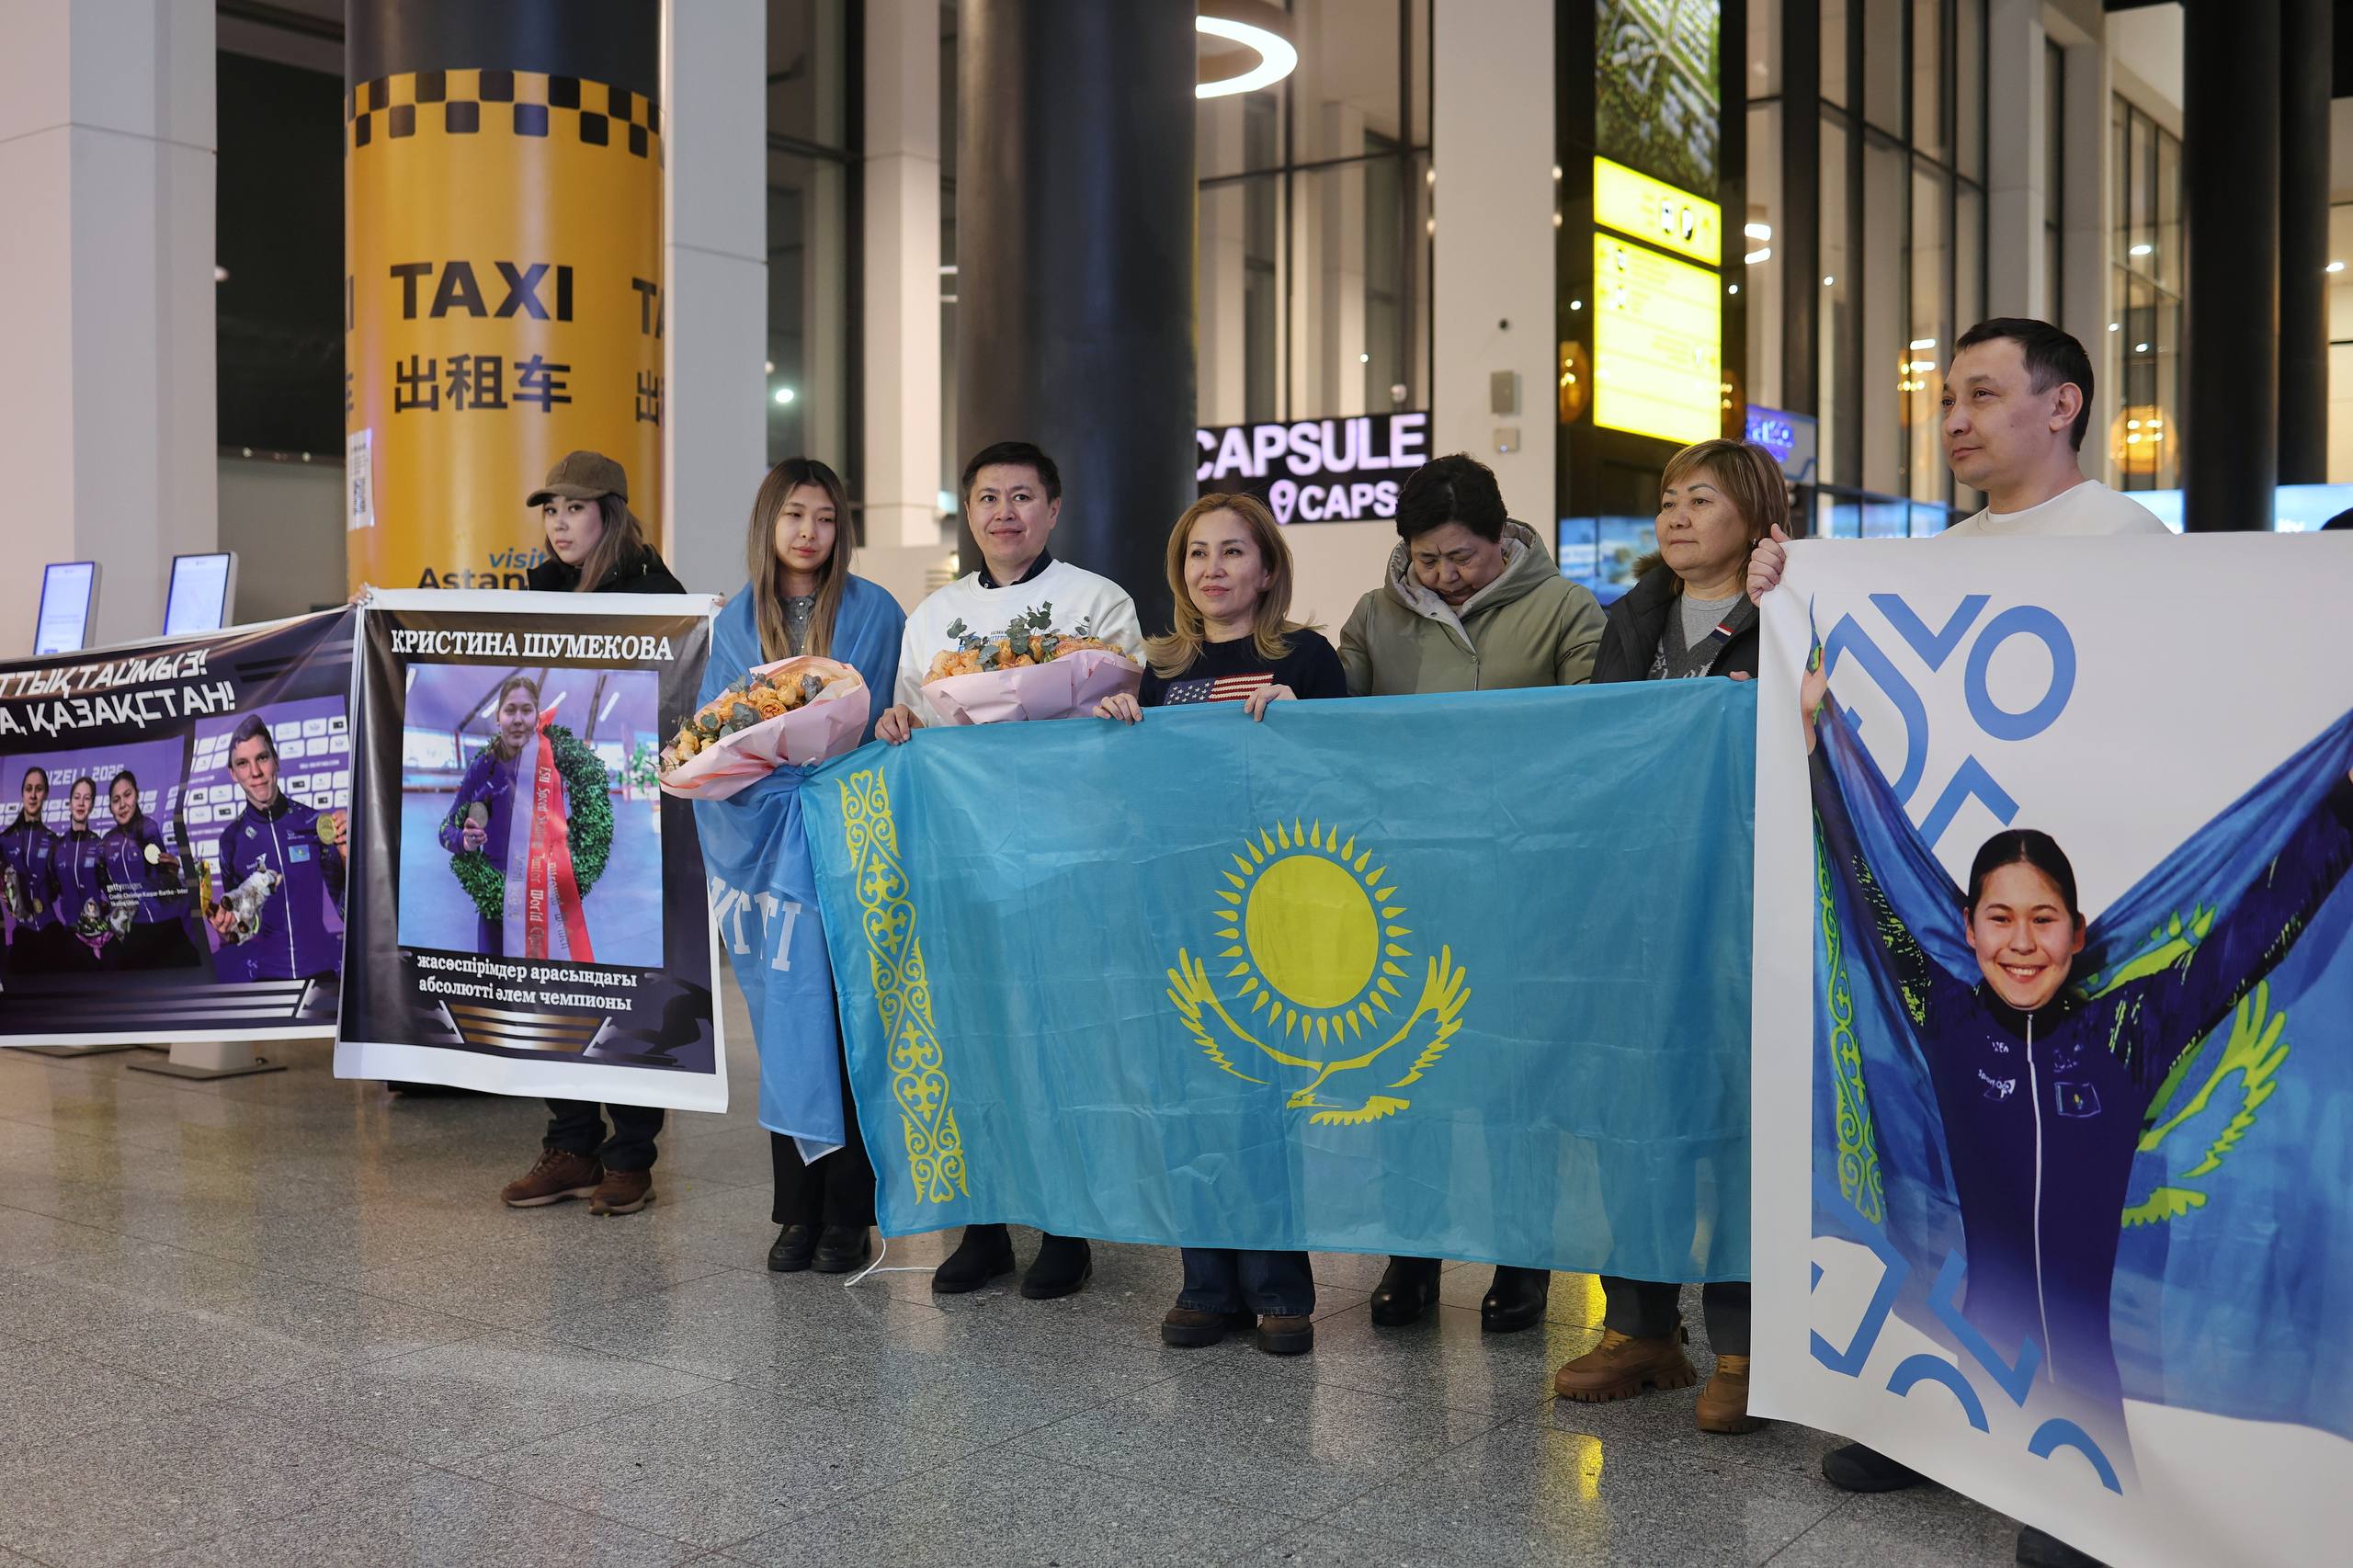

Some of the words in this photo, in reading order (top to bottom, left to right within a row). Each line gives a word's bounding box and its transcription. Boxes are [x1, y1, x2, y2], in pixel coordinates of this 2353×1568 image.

[390, 261, 574, 322] TAXI
[394, 353, 573, 413] 出租车
[1196, 413, 1427, 482] CAPSULE
[489, 547, 545, 568] visit
[418, 567, 528, 590] Astan
[391, 629, 518, 656] КРИСТИНА
[523, 632, 675, 661] ШУМЕКОВА
[26, 680, 236, 737] ҚАЗАҚСТАН!
[417, 953, 528, 983] жасөспірімдер
[530, 967, 637, 988] арасындағы
[419, 976, 494, 1000] абсолютті
[494, 988, 536, 1005] әлем
[540, 993, 632, 1011] чемпионы
